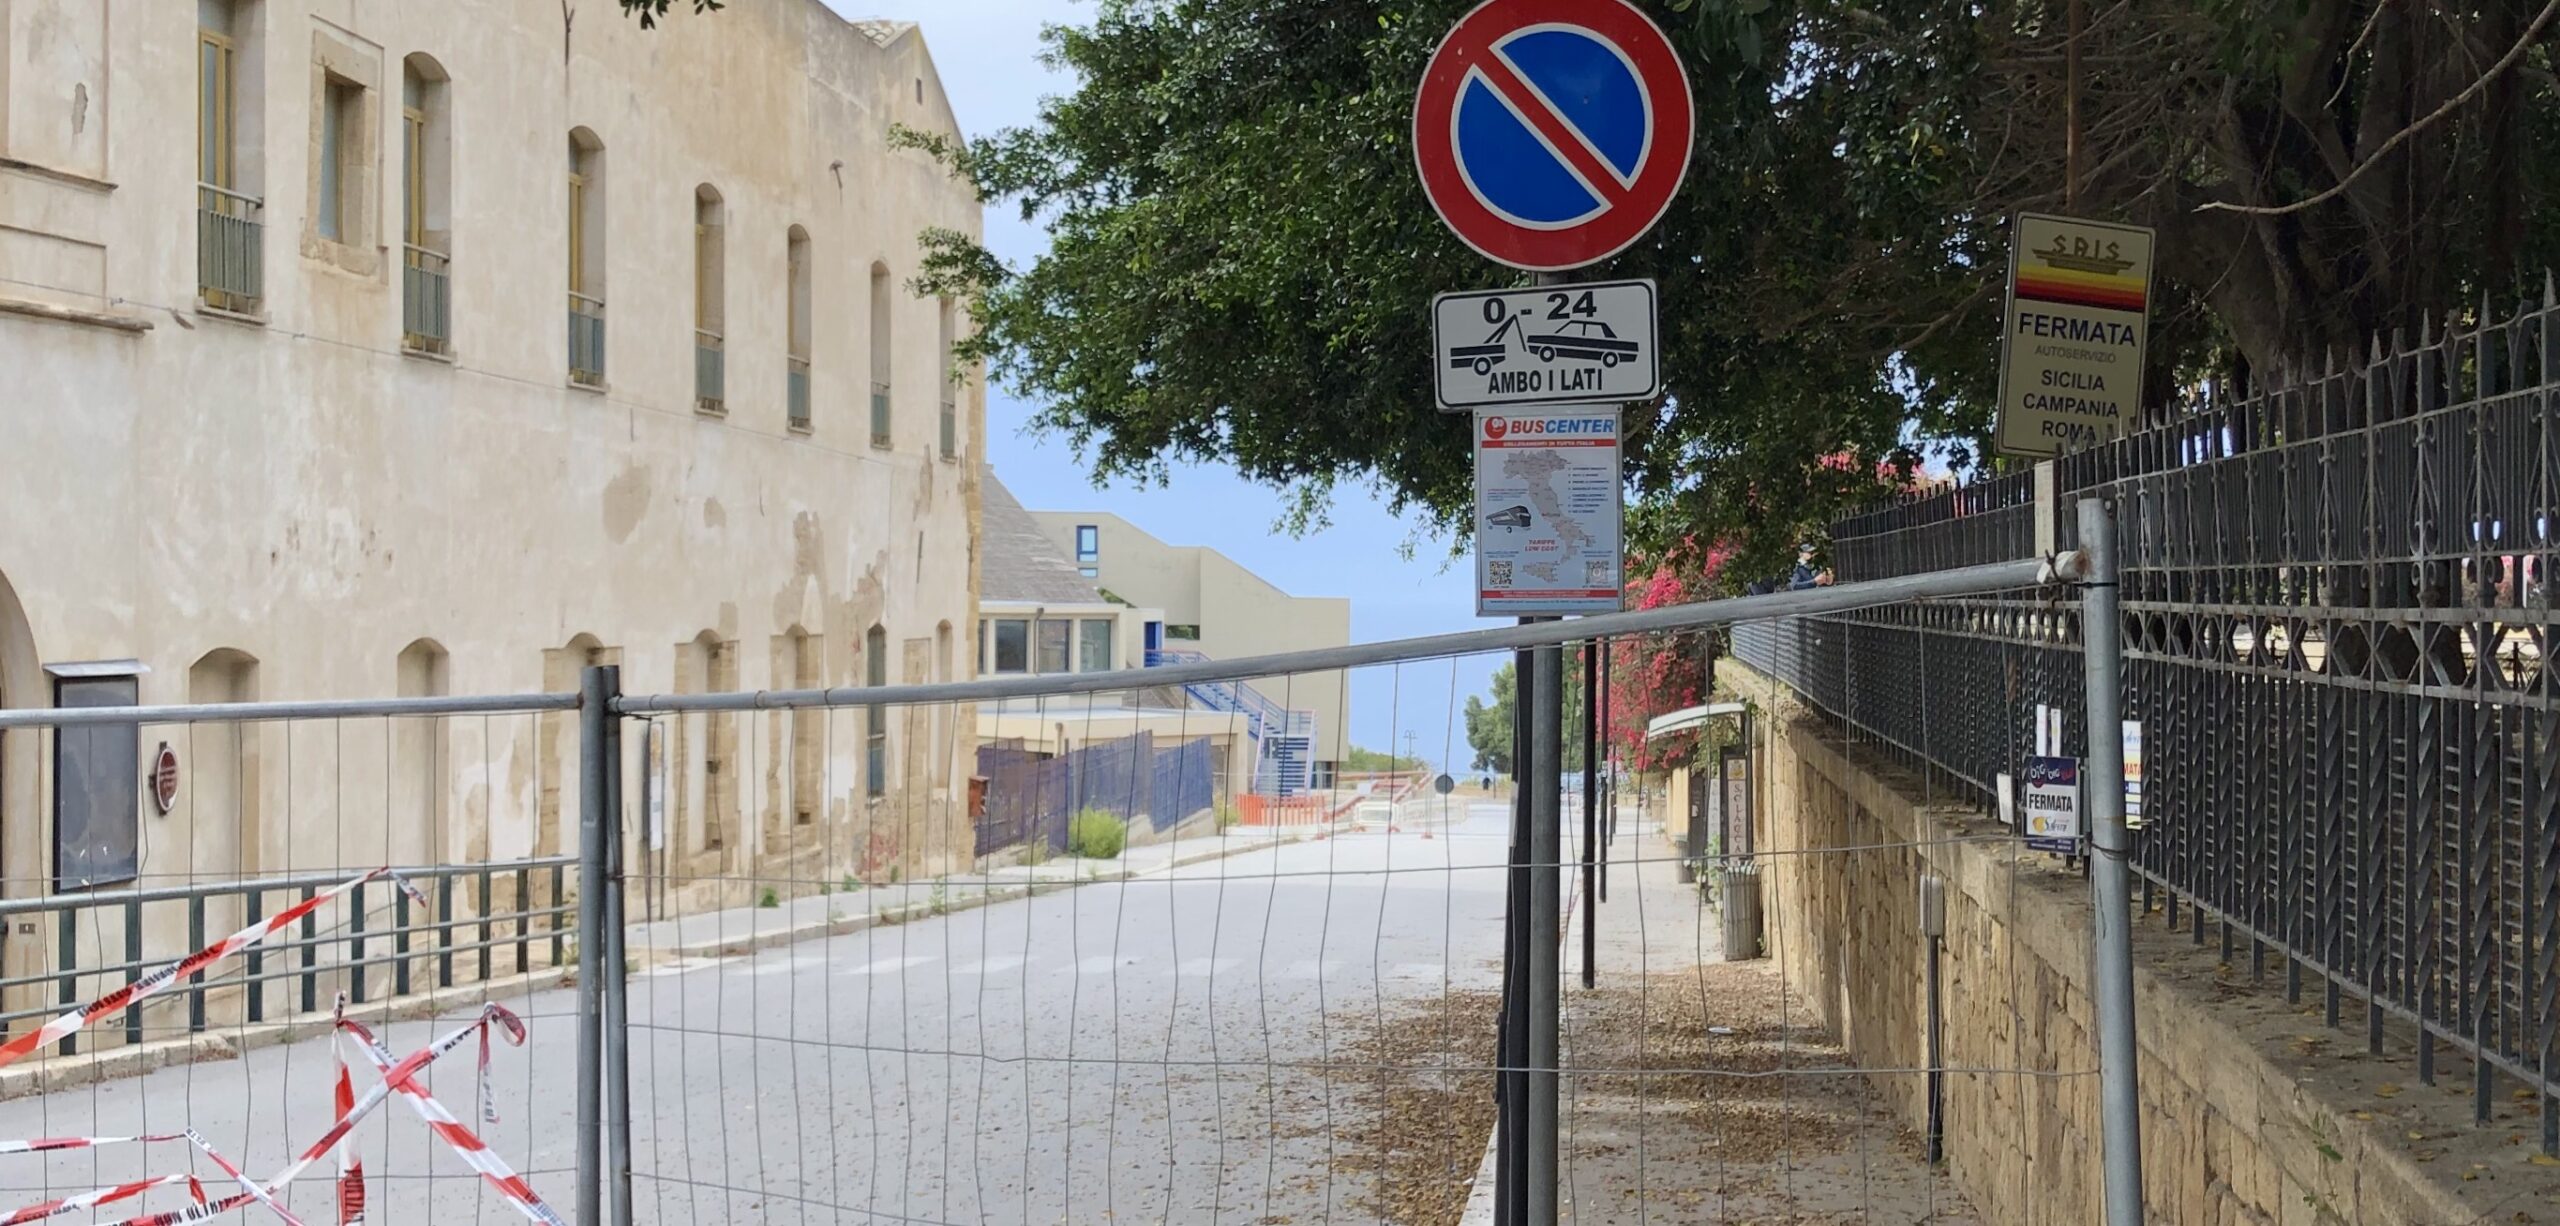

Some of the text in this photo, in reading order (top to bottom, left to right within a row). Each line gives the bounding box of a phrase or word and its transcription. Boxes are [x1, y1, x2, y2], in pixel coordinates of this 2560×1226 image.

[1483, 297, 1506, 324] 0
[1547, 291, 1597, 320] 24
[2018, 312, 2136, 347] FERMATA
[2034, 344, 2117, 364] AUTOSERVIZIO
[1488, 368, 1603, 394] AMBO I LATI
[2041, 369, 2105, 391] SICILIA
[2023, 393, 2119, 419] CAMPANIA
[1510, 418, 1615, 434] BUSCENTER
[2042, 420, 2097, 441] ROMA
[2029, 793, 2073, 813] FERMATA
